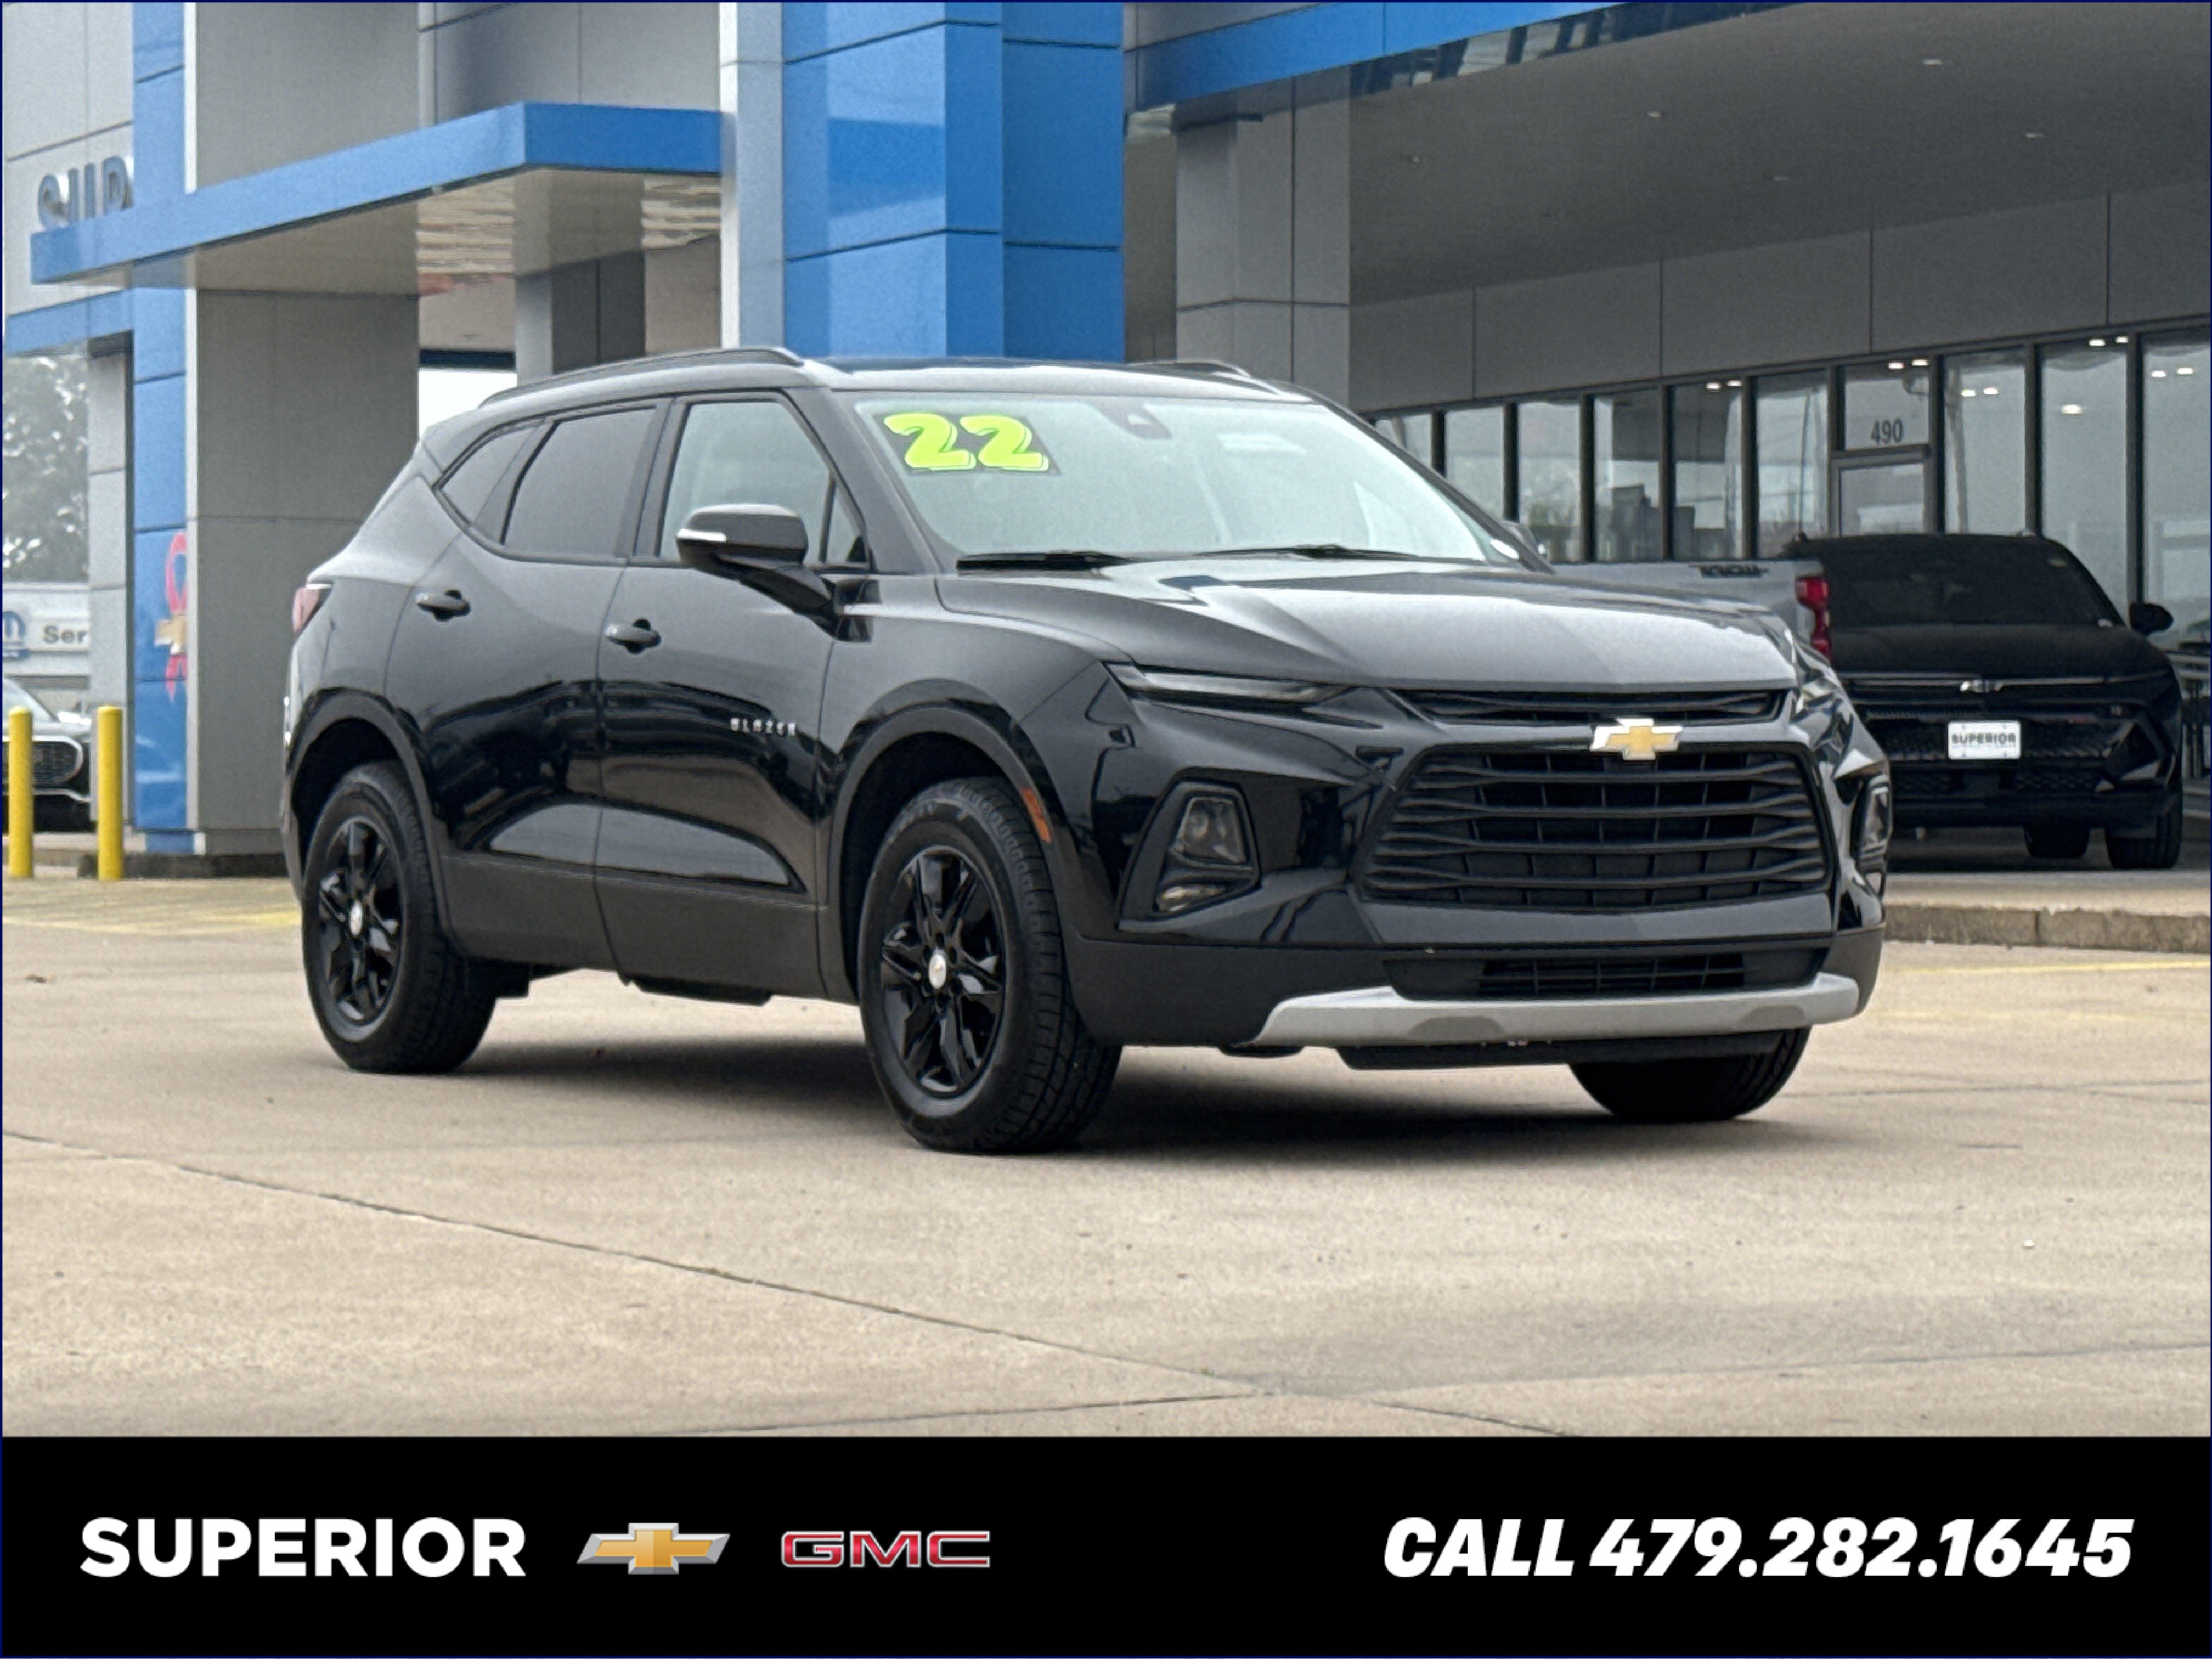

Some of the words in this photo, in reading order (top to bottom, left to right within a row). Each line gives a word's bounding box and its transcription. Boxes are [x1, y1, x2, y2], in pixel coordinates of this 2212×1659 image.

[883, 413, 1049, 471] 22
[1870, 419, 1904, 445] 490
[43, 624, 87, 644] Ser
[1951, 732, 2017, 744] SUPERIOR
